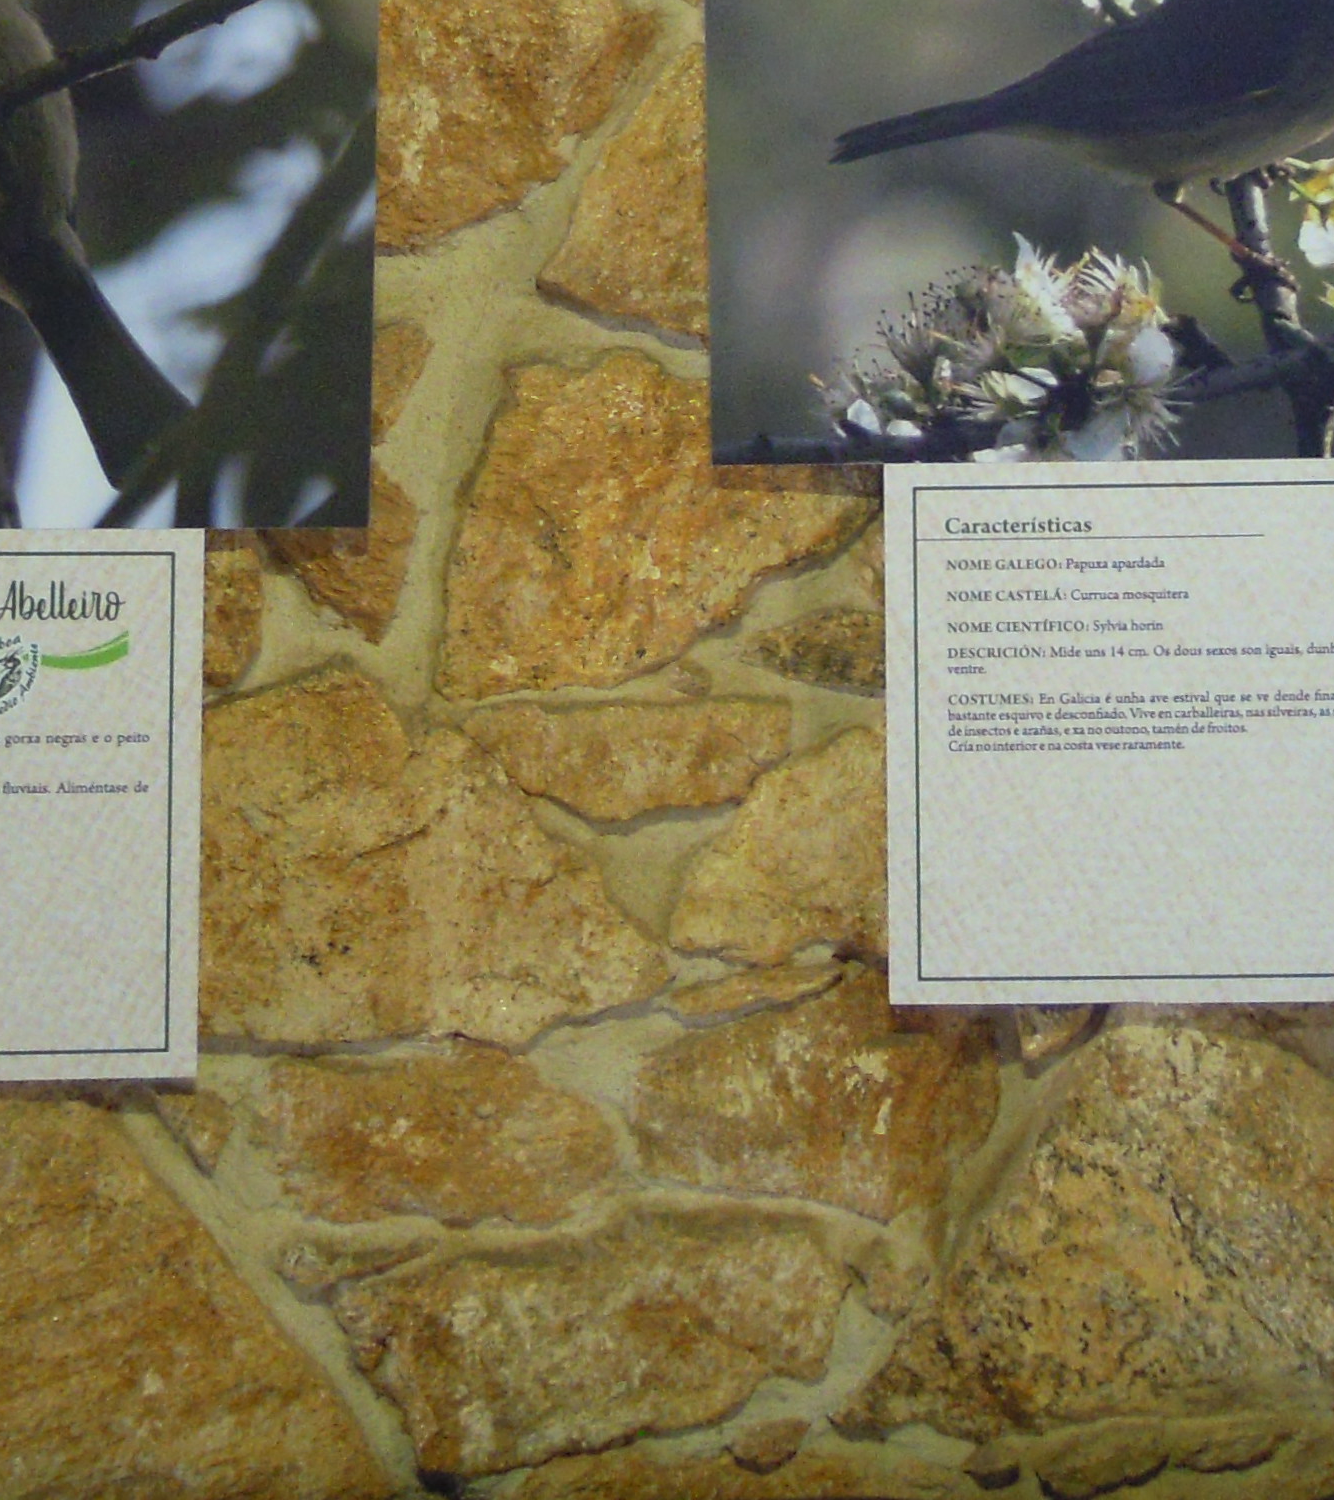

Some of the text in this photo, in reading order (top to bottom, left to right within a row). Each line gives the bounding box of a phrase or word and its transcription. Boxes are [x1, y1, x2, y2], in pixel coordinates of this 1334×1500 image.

[944, 517, 1092, 534] Características
[946, 555, 1165, 573] NOME GALEGO: Papuxa apardada
[947, 587, 1189, 603] NOME CASTELÁ: Curruca mosquitera
[947, 621, 992, 634] NOME
[996, 618, 1089, 633] CIENTÍFICO:
[1093, 619, 1128, 634] Sylvia
[947, 646, 1046, 660] DESCRICIÓN:
[1050, 645, 1080, 659] Mide
[1085, 648, 1106, 658] uns
[1110, 645, 1124, 658] 14
[1152, 644, 1170, 657] Os
[1174, 644, 1202, 657] dous
[1206, 647, 1238, 657] sexos
[1242, 646, 1262, 656] son
[948, 693, 1034, 706] COSTUMES:
[1039, 692, 1055, 705] En
[1059, 691, 1101, 705] Galicia
[1115, 691, 1145, 704] unha
[1149, 694, 1169, 704] ave
[1173, 690, 1210, 704] estival
[1214, 694, 1236, 706] que
[1240, 693, 1252, 703] se
[1256, 693, 1269, 703] ve
[1273, 689, 1310, 702] dende
[948, 708, 996, 722] bastante
[998, 711, 1044, 725] esquivo
[1131, 707, 1156, 720] Vive
[1158, 710, 1172, 720] en
[1245, 709, 1265, 718] nas
[1319, 707, 1331, 717] as
[948, 724, 963, 737] de
[964, 726, 1011, 737] insectos
[1071, 726, 1085, 736] xa
[1087, 726, 1103, 736] no
[1191, 721, 1206, 735] de
[5, 734, 41, 748] gorxa
[46, 734, 87, 747] negras
[117, 733, 150, 747] peito
[975, 742, 990, 752] no
[991, 741, 1038, 752] interior
[1047, 742, 1062, 752] na
[1064, 740, 1093, 751] costa
[1095, 741, 1121, 751] vese
[133, 780, 149, 794] de
